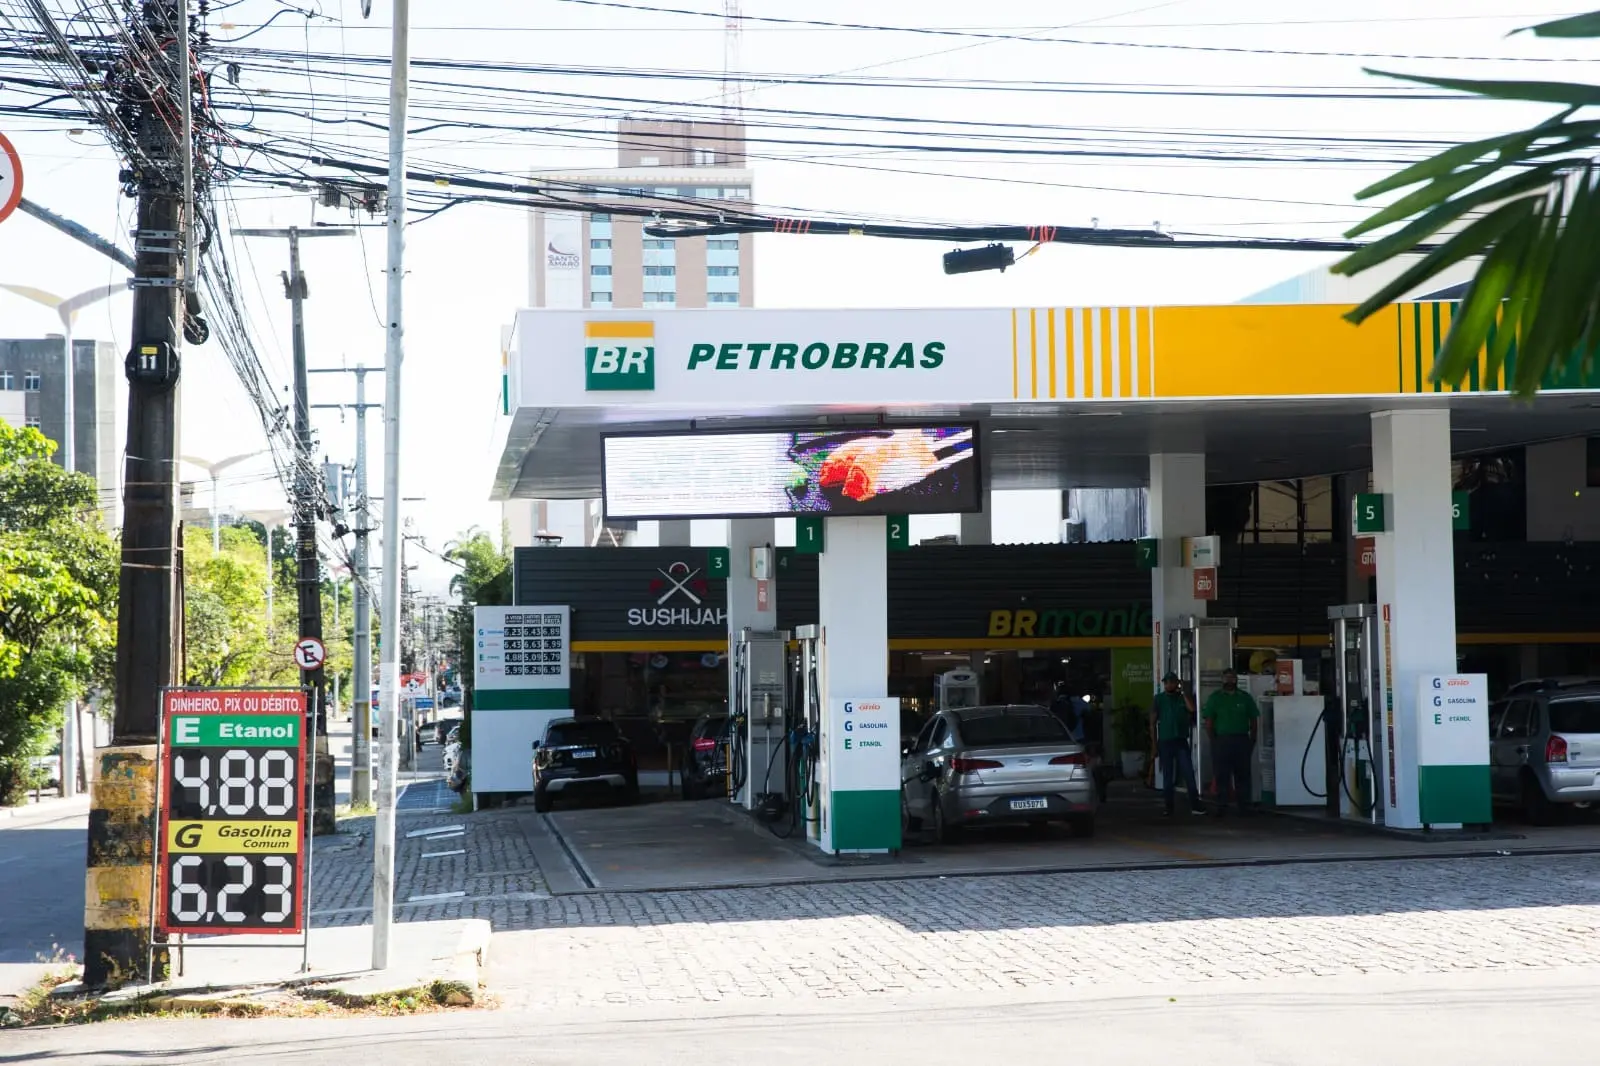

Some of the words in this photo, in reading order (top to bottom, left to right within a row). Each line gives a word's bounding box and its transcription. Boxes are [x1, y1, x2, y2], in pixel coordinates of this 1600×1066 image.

[140, 355, 156, 369] 11
[591, 346, 649, 374] BR
[687, 341, 946, 370] PETROBRAS
[1366, 505, 1375, 520] 5
[1452, 504, 1460, 518] 6
[806, 526, 814, 541] 1
[891, 524, 900, 539] 2
[1143, 548, 1151, 559] 7
[715, 557, 723, 568] 3
[779, 556, 788, 567] 4
[479, 628, 484, 636] G
[1432, 678, 1441, 689] G
[170, 697, 222, 712] DINHEIRO,
[225, 697, 241, 711] PIX
[243, 698, 259, 711] OU
[261, 694, 302, 712] DÉBITO.
[844, 702, 853, 713] G
[1433, 696, 1442, 707] G
[844, 720, 853, 732] G
[1434, 713, 1442, 725] E
[176, 717, 200, 743] E
[219, 723, 294, 738] Etanol
[844, 738, 852, 750] E
[174, 750, 294, 816] 4,88
[174, 824, 203, 848] G
[218, 825, 292, 838] Gasolina
[243, 839, 289, 848] Comum
[172, 856, 292, 922] 6,23
